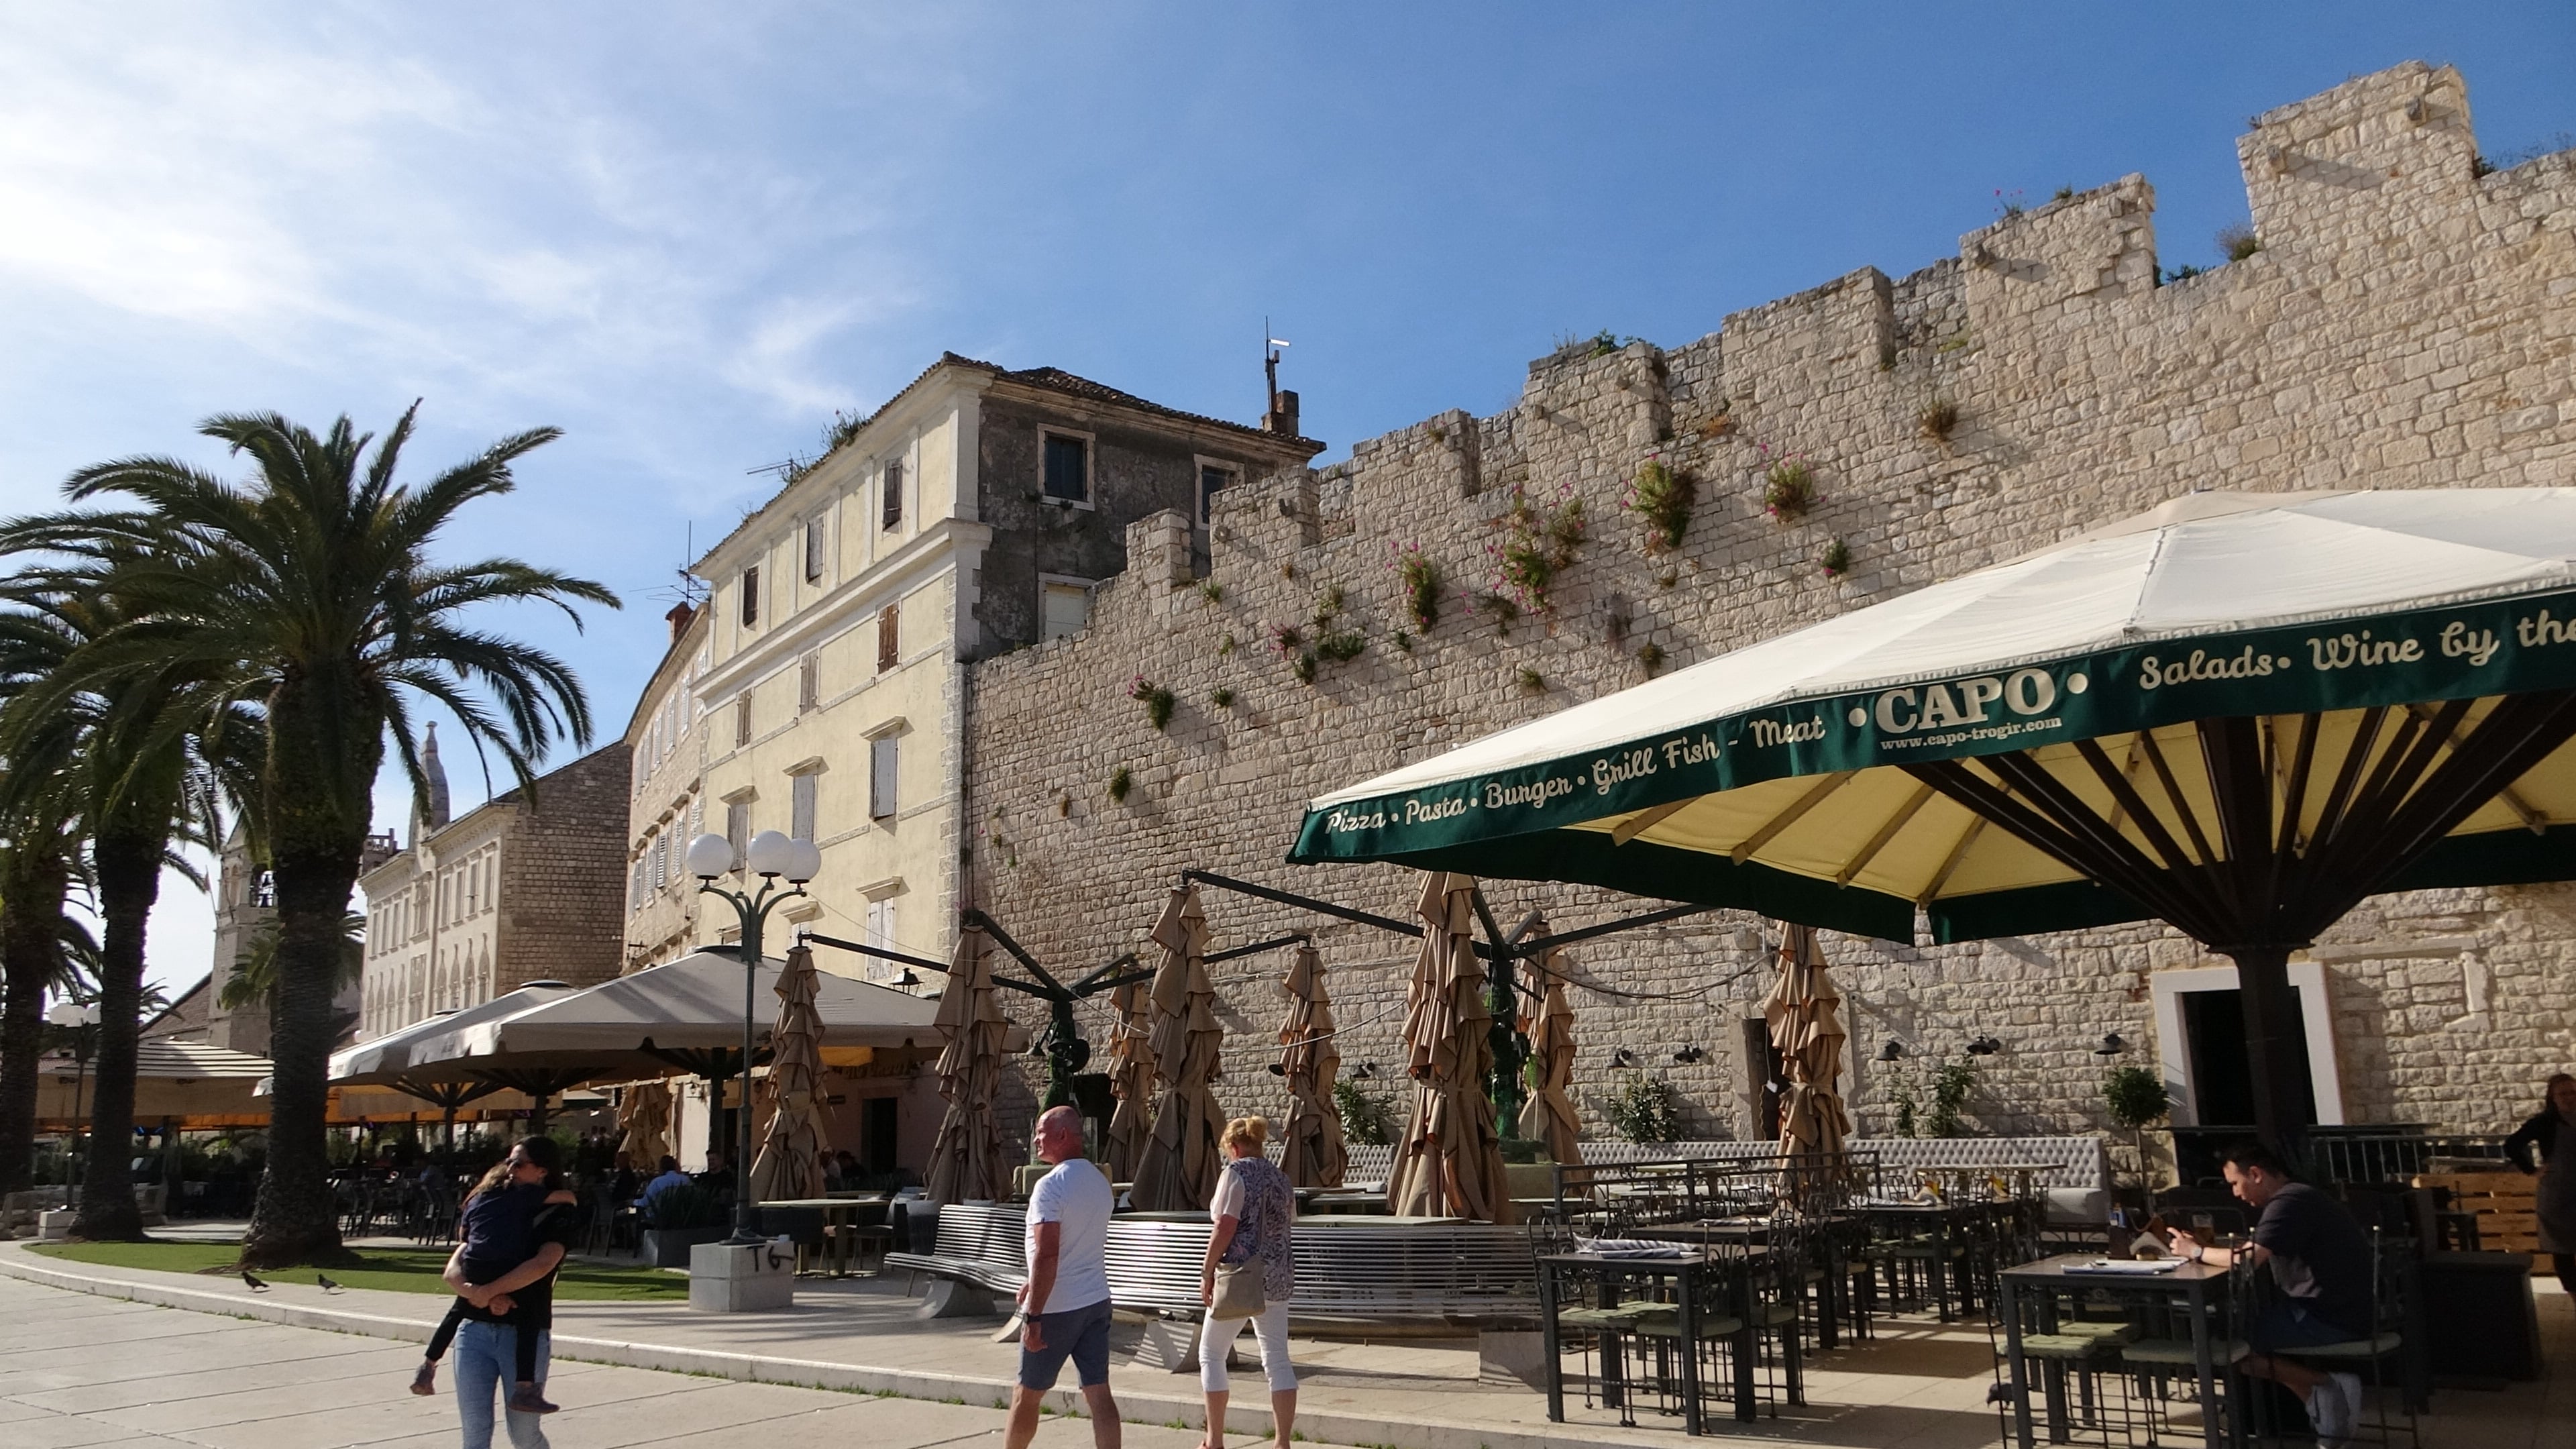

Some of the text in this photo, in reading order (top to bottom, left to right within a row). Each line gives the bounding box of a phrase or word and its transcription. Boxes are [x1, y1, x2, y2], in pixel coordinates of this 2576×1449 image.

[2139, 645, 2273, 690] Salads
[2306, 629, 2425, 672] Wine
[2438, 621, 2501, 667] by
[1875, 668, 2056, 733] CAPO
[1880, 716, 2063, 750] www.capo-trogir.com
[1325, 812, 1387, 835] Pizza
[1405, 797, 1468, 825] Pasta
[1484, 777, 1573, 809] Burger
[1591, 747, 1658, 796] Grill
[1663, 733, 1721, 769] Fish
[1748, 714, 1826, 748] Meat
